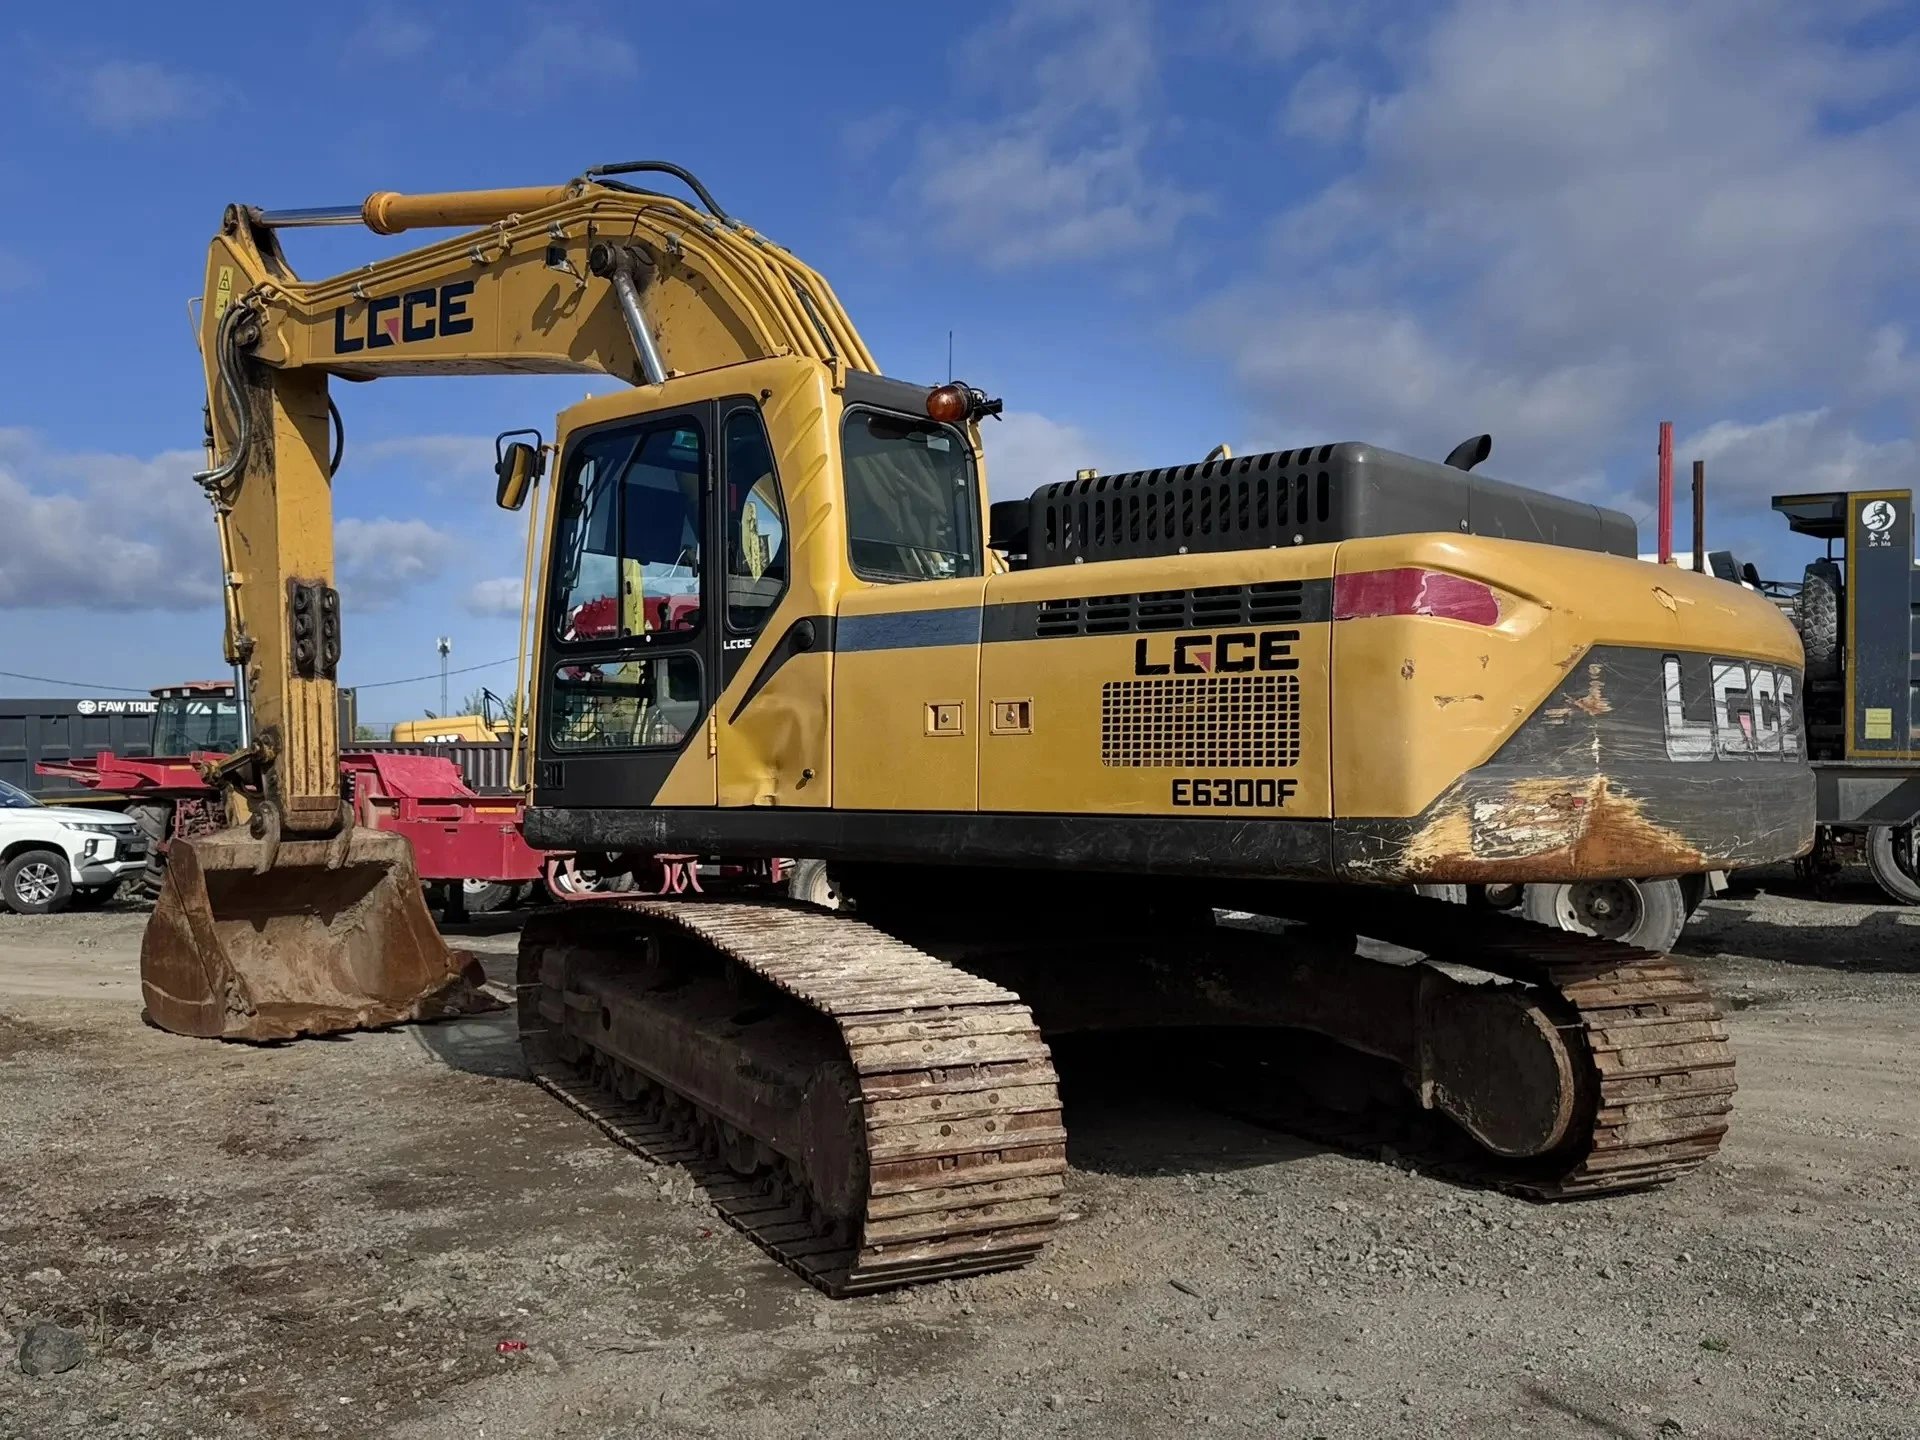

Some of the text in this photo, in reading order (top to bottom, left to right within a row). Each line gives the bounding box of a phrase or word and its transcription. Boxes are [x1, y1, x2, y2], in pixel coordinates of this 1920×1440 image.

[98, 701, 166, 713] FAW TRUC
[1172, 779, 1298, 807] E6300F
